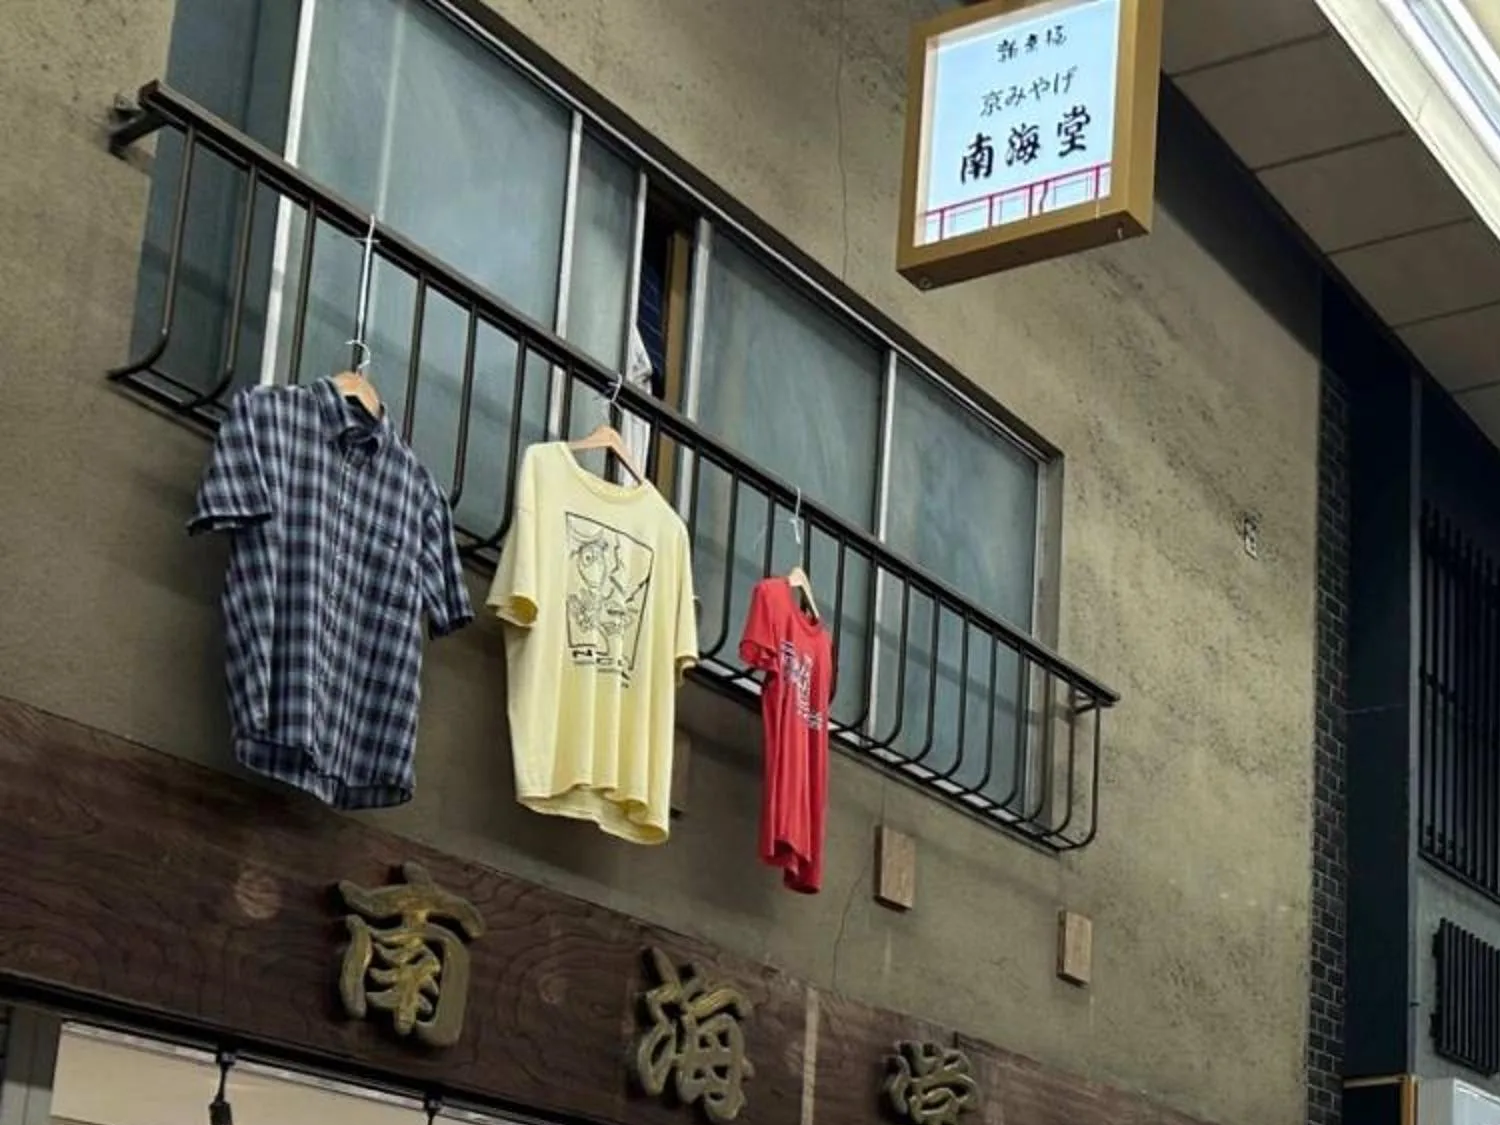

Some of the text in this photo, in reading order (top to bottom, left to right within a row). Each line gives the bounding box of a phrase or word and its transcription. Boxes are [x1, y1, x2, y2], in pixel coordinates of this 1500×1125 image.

[979, 66, 1078, 117] 京みやげ
[960, 104, 1091, 184] 南海堂
